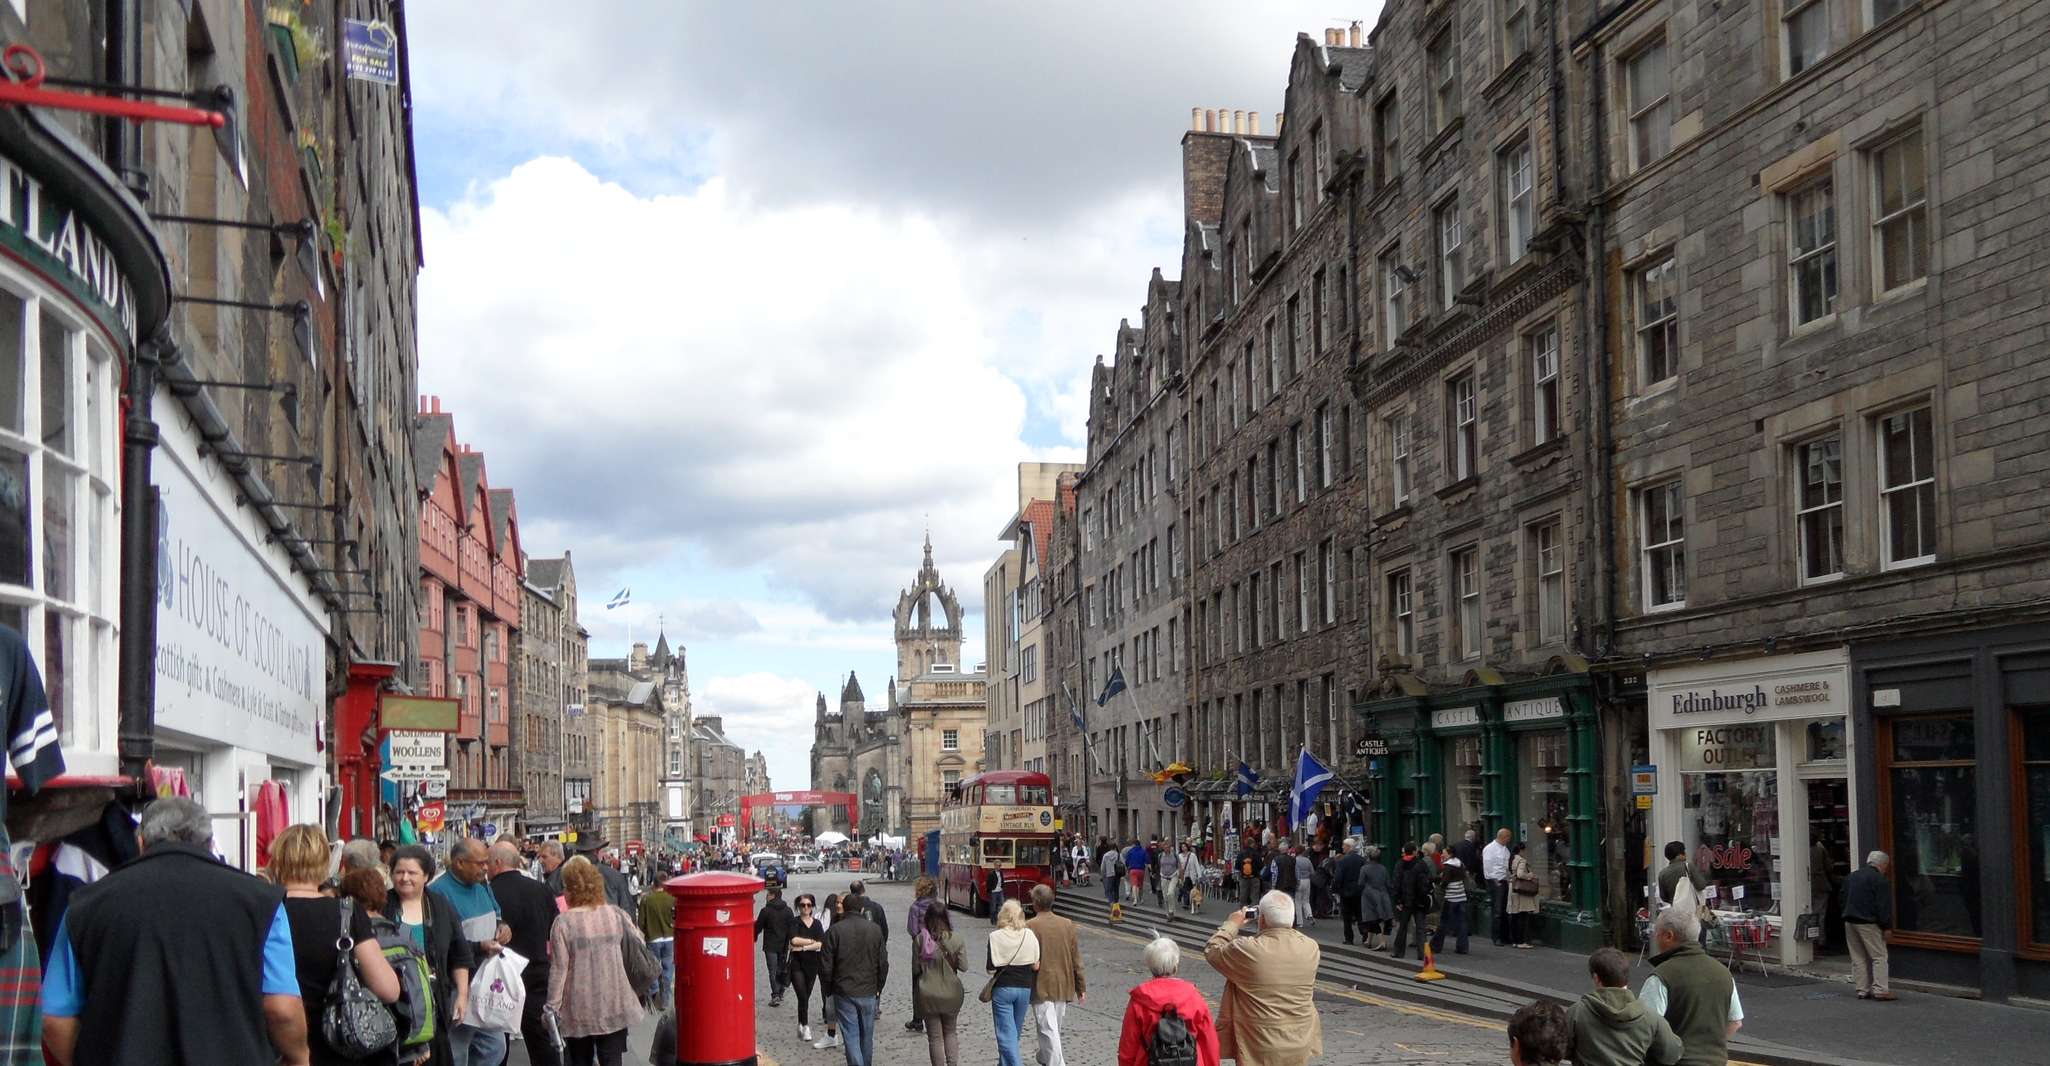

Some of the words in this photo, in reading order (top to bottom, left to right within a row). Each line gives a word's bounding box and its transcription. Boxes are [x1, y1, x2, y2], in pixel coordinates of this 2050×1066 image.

[178, 538, 230, 648] HOUSE
[234, 594, 250, 661] OF
[254, 611, 304, 697] SCOTLAND
[156, 643, 185, 683] cottish
[187, 652, 202, 698] gifts
[1672, 685, 1768, 714] Edinburgh
[1775, 682, 1821, 694] CASHMERE
[1822, 681, 1829, 690] &
[1775, 693, 1831, 706] LAMBSWOOL
[413, 738, 421, 746] &
[1697, 727, 1765, 745] FACTORY
[1356, 747, 1389, 756] ANTIQUES
[1360, 740, 1385, 748] CASTLE
[392, 747, 442, 758] WOOLLENS
[1713, 840, 1752, 869] Sale
